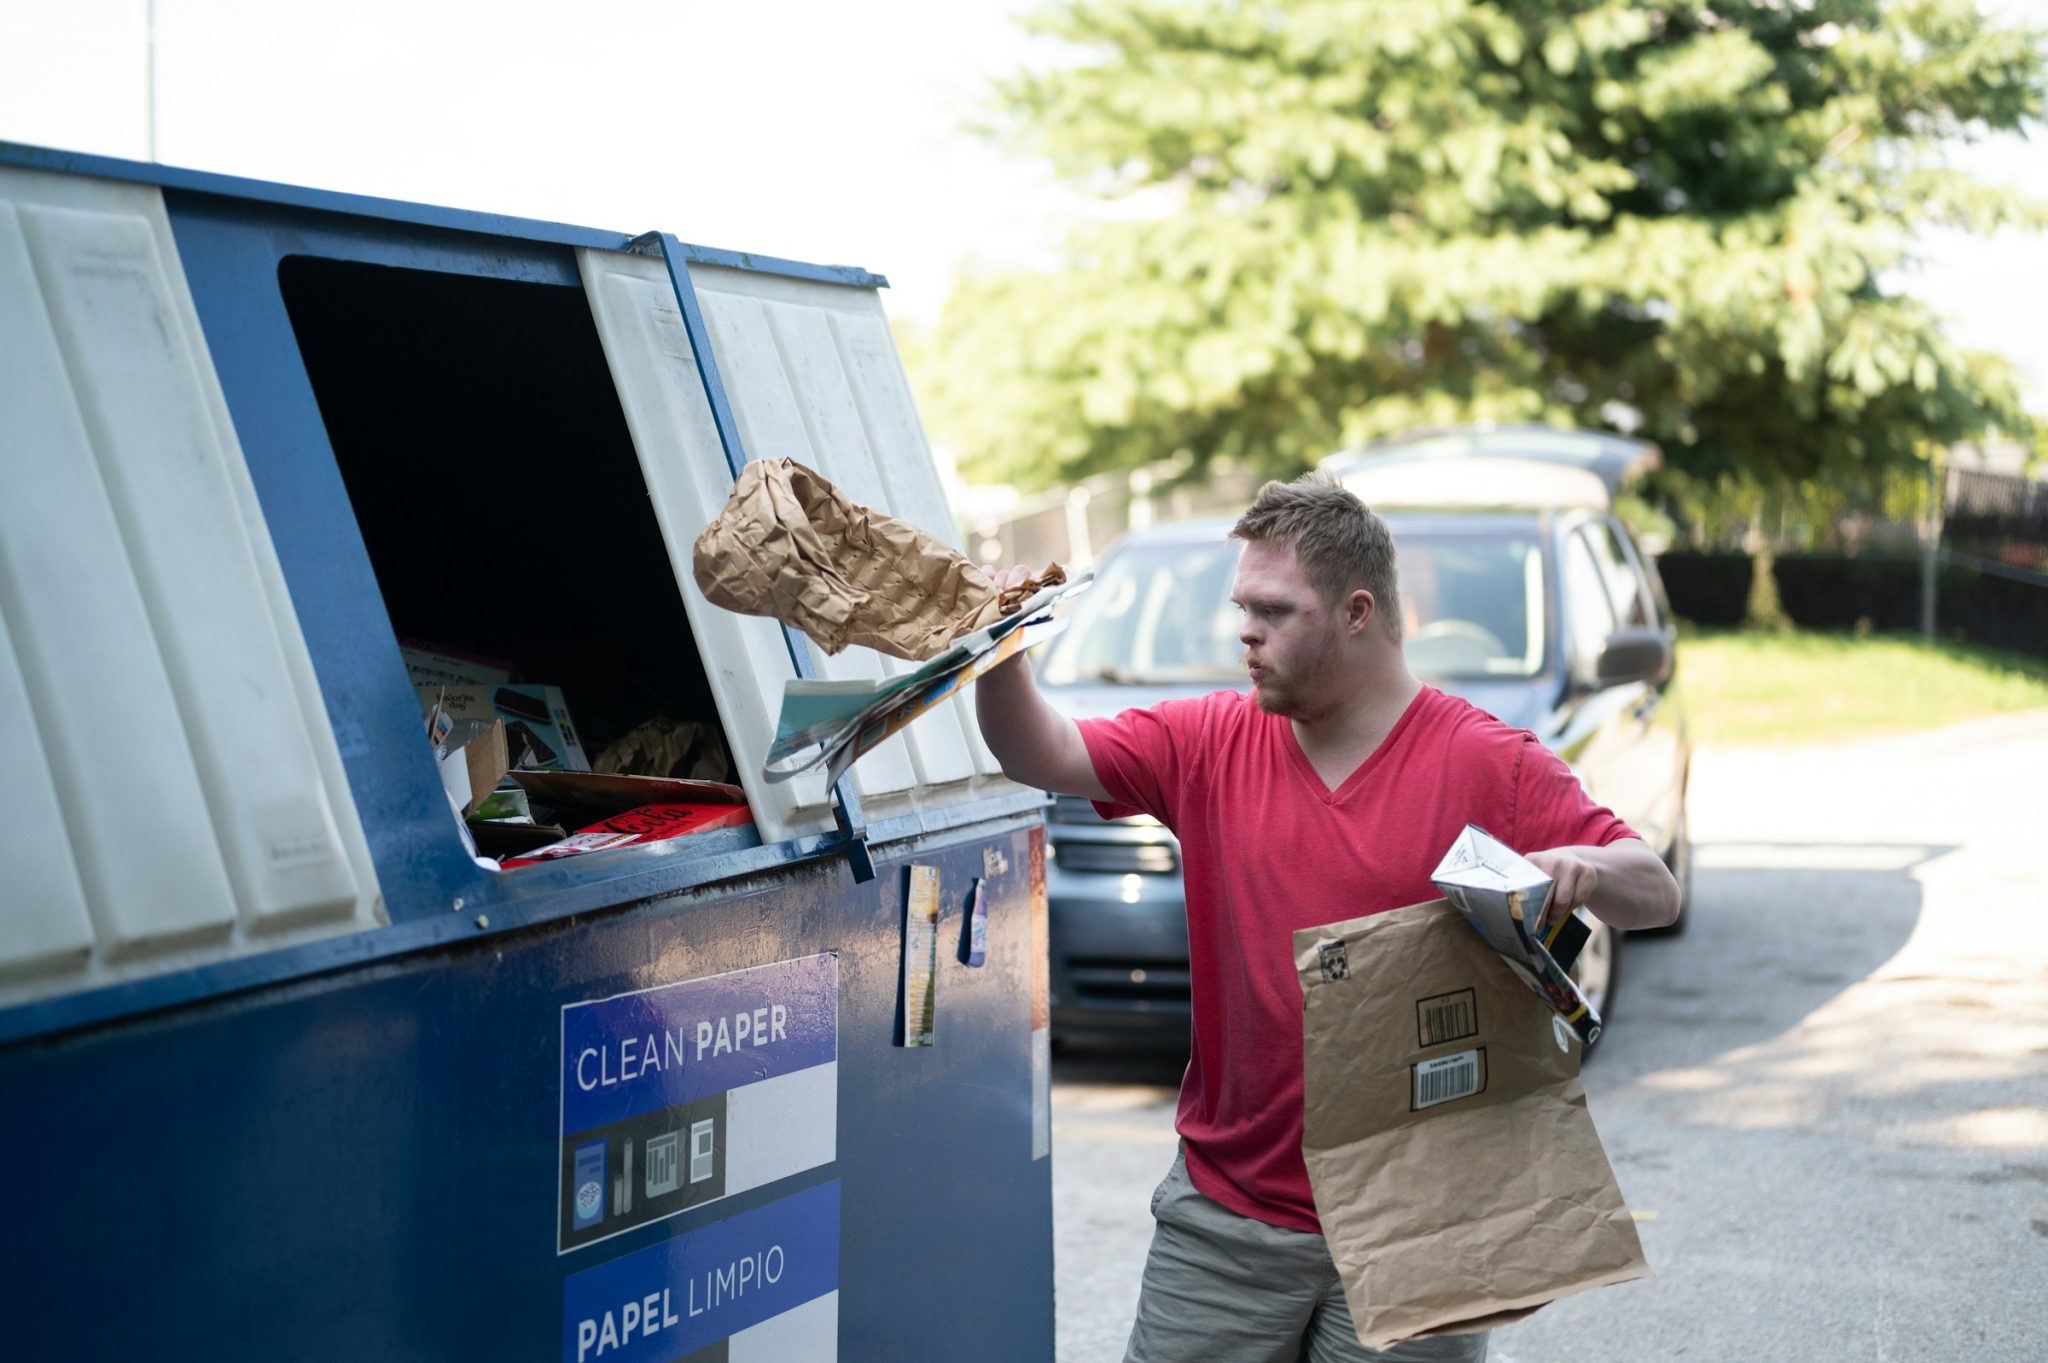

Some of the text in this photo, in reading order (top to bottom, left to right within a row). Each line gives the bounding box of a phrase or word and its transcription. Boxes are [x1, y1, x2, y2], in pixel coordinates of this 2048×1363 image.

[605, 806, 693, 834] Cola
[577, 1004, 787, 1091] CLEAN PAPER
[577, 1245, 784, 1363] PAPEL LIMPIO
